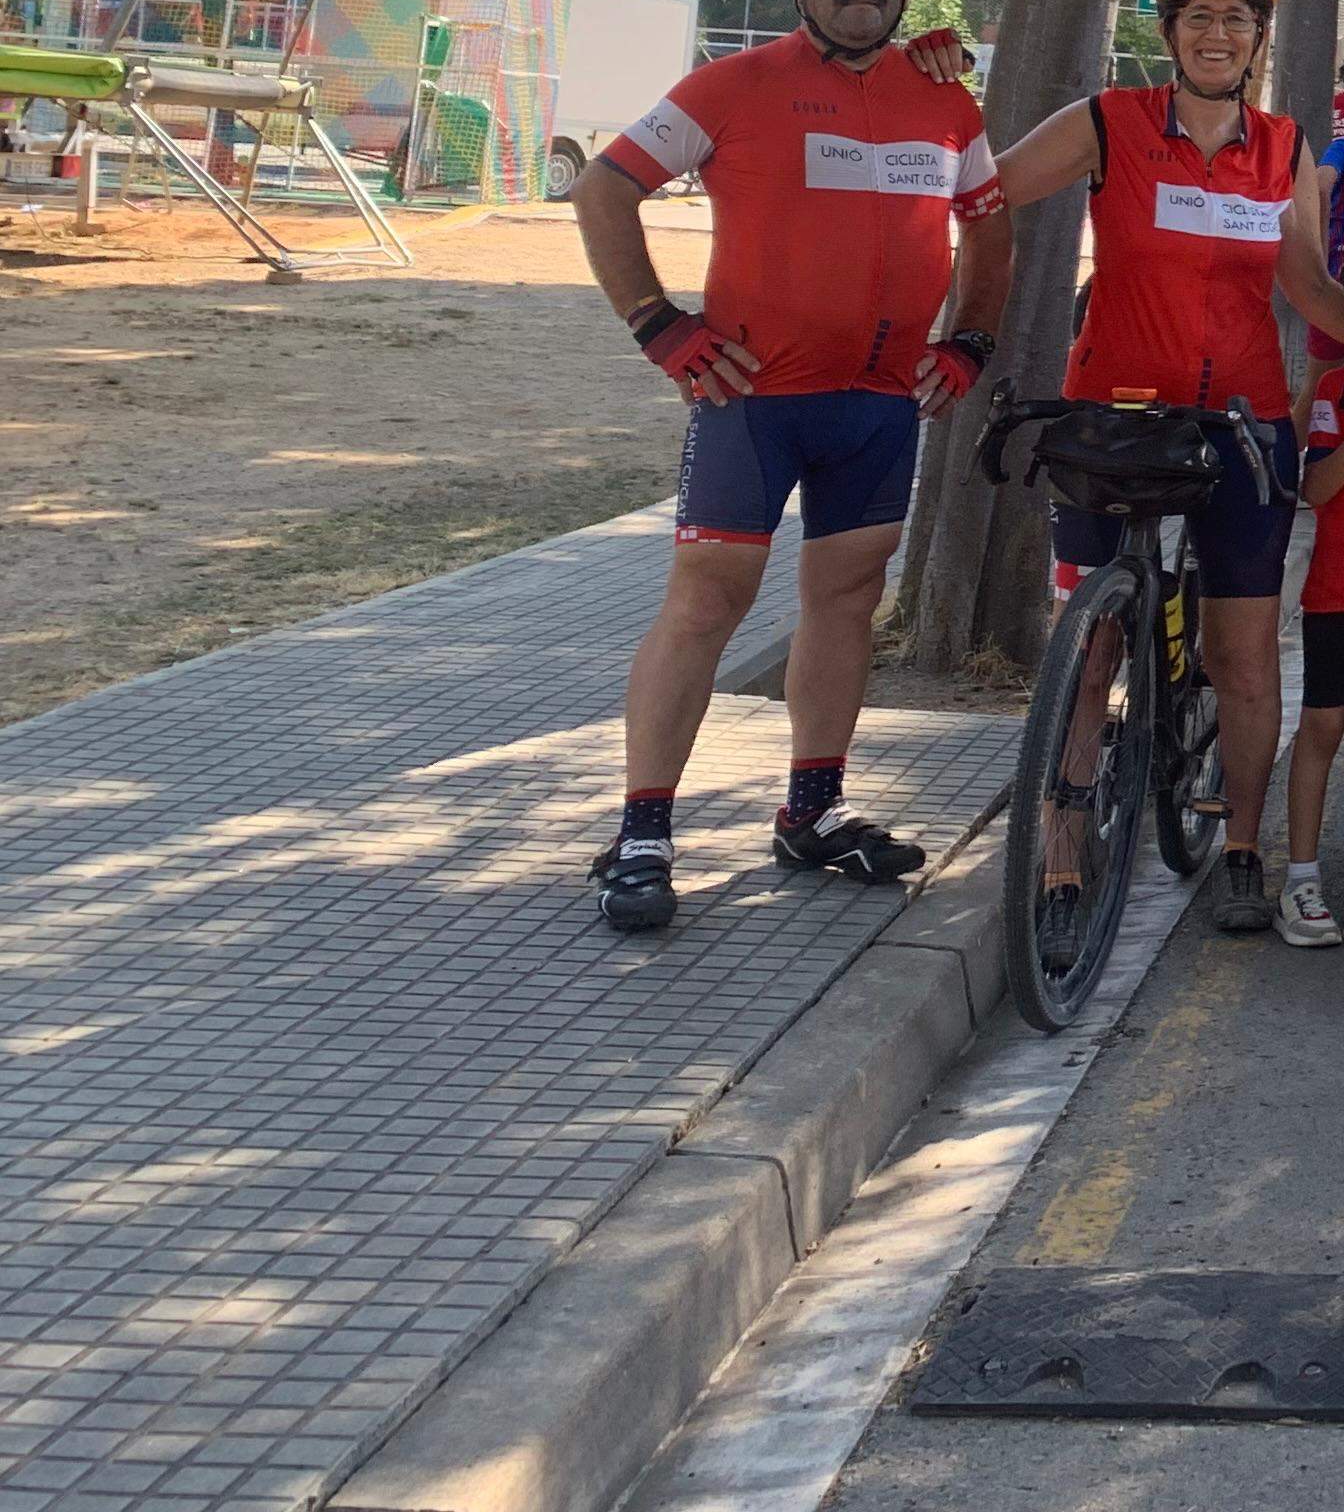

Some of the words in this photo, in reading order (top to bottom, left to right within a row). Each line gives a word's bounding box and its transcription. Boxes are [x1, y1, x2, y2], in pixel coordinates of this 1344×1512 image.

[820, 144, 862, 162] UNIÓ
[885, 153, 938, 167] CICLISTA
[888, 172, 920, 186] SANT
[923, 173, 953, 188] CUGA
[1169, 194, 1205, 208] UNIÓ
[1223, 218, 1255, 233] SANT
